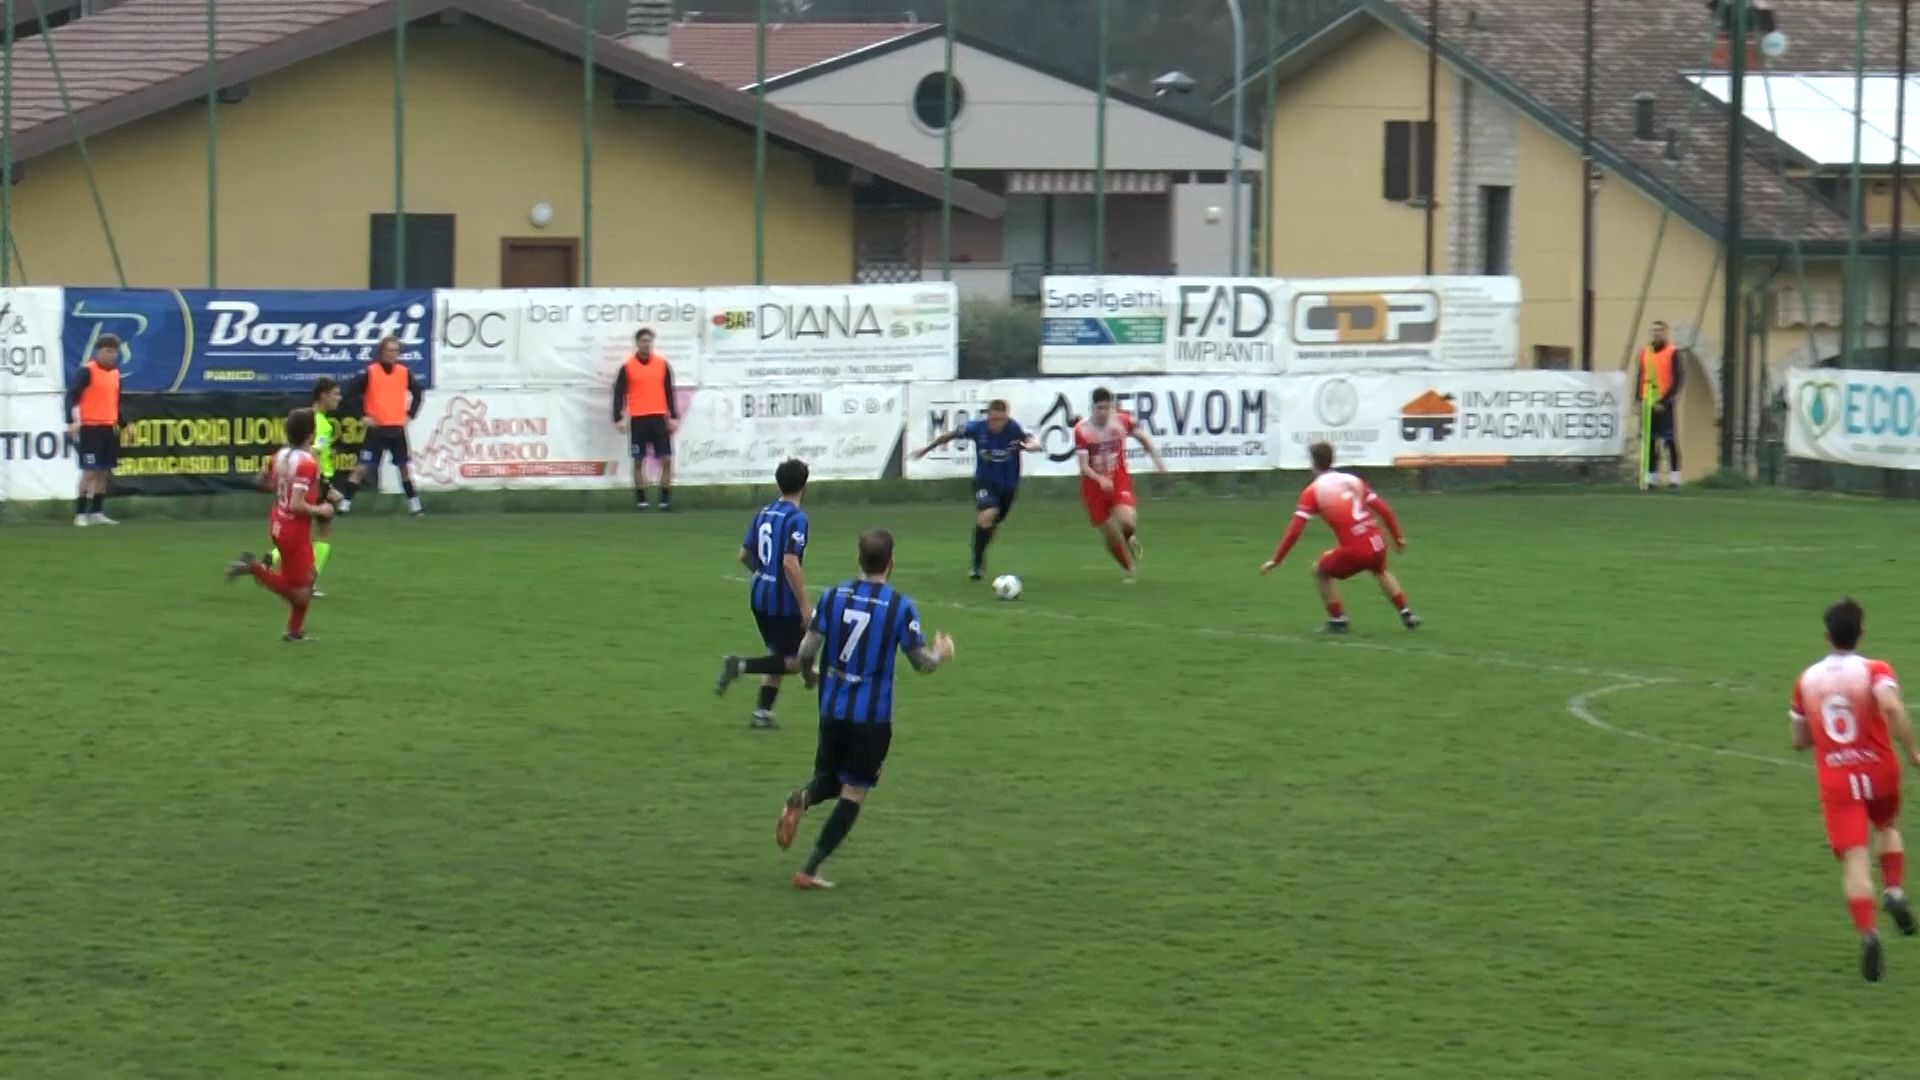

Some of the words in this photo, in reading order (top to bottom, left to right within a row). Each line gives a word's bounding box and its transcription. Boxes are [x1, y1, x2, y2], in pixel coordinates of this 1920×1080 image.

[205, 300, 426, 346] Bonetti
[529, 300, 571, 323] bar
[585, 297, 696, 323] centrale
[759, 294, 883, 341] DIANA
[1175, 341, 1274, 362] IMPIANTI
[1461, 390, 1618, 408] IMPRESA
[758, 522, 773, 566] 6
[839, 608, 871, 662] 7
[1822, 694, 1858, 744] 6
